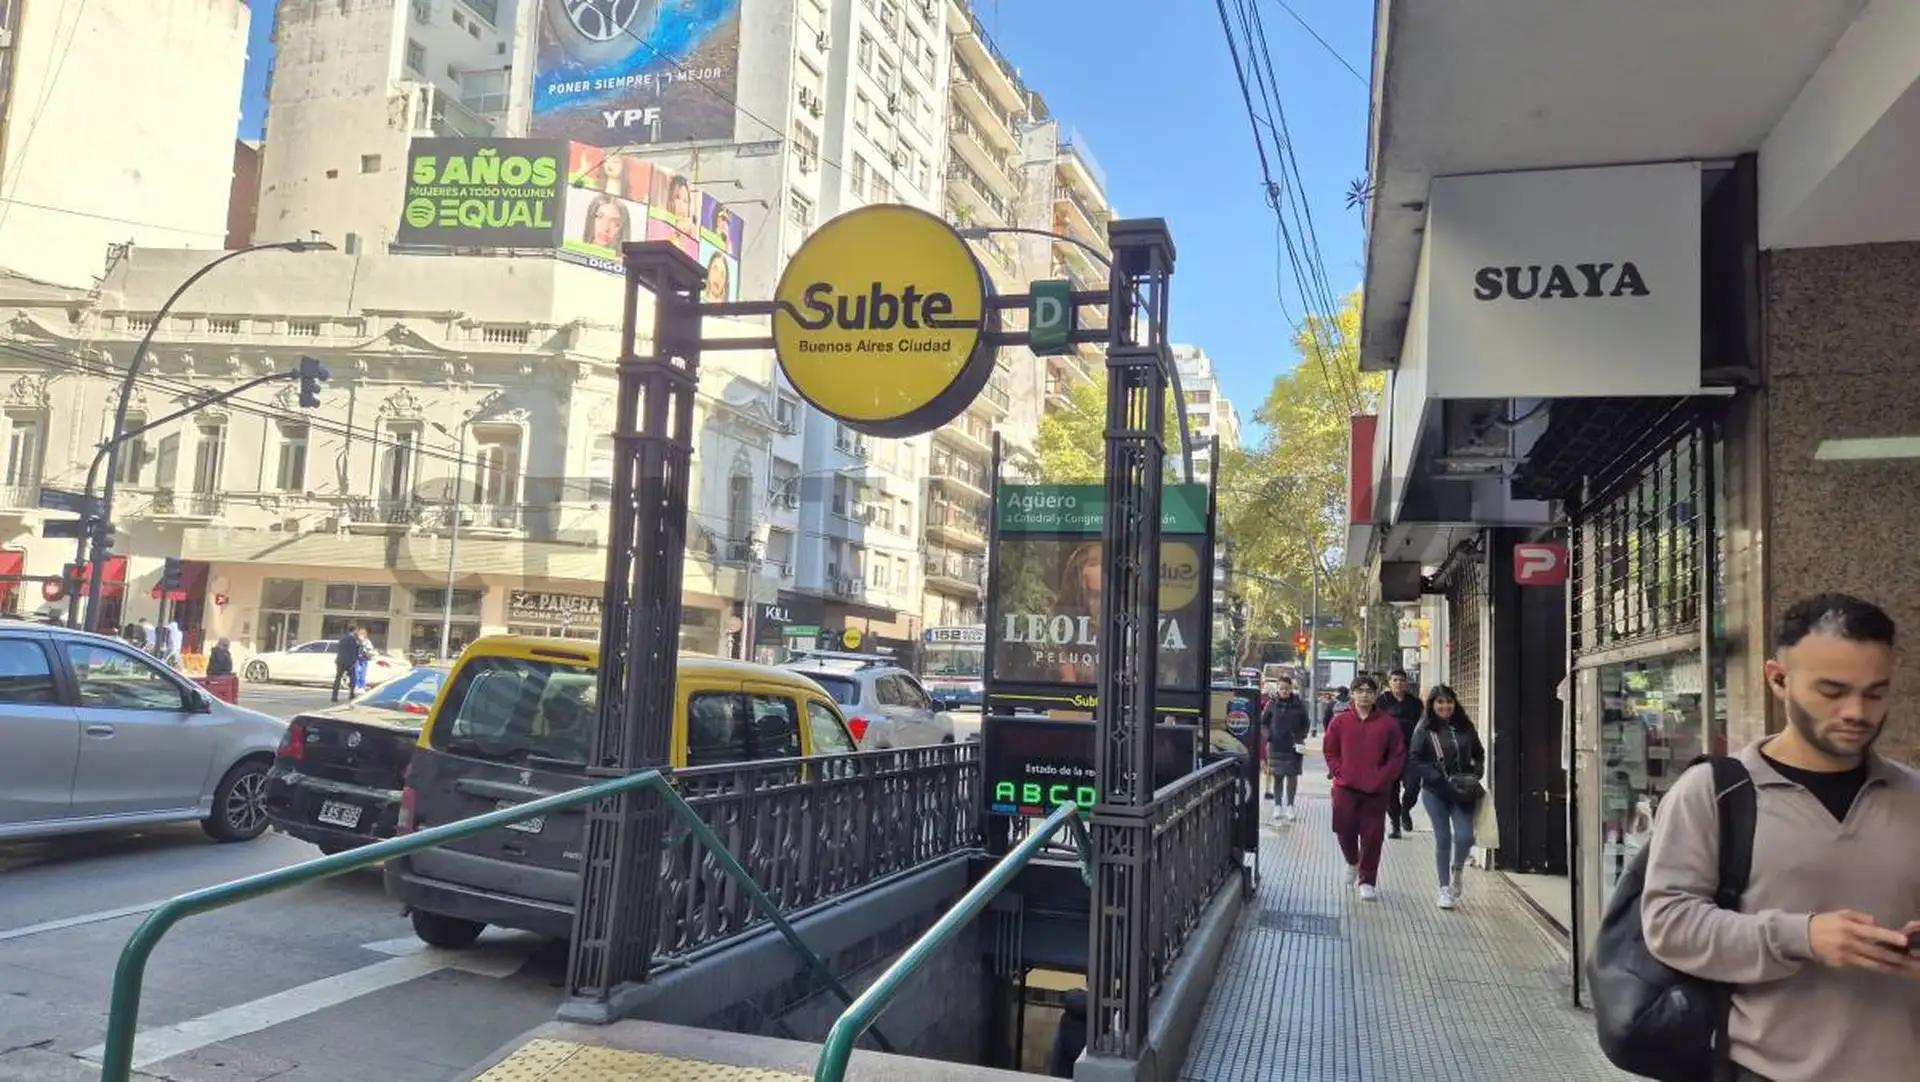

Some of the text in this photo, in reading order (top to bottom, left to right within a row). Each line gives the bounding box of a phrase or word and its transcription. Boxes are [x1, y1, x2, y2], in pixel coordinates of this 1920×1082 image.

[549, 79, 590, 95] PONER
[594, 74, 652, 90] SIEMPRE
[677, 67, 722, 82] MEJOR
[602, 107, 662, 128] YPF
[413, 148, 557, 187] 5 AÑOS
[409, 187, 555, 198] MUJERES A TODO VOLUMEN
[440, 198, 553, 229] EQUAL
[1473, 262, 1650, 301] SUAYA
[802, 281, 953, 331] Subte
[1036, 296, 1062, 328] D
[799, 338, 951, 353] Buenos Aires Ciudad
[1007, 491, 1077, 512] Agüero
[1065, 513, 1104, 526] Congre
[540, 593, 600, 614] PANERA
[935, 630, 961, 640] 152
[1025, 763, 1057, 775] Estado
[1059, 765, 1071, 776] de
[1073, 766, 1082, 777] la
[996, 782, 1097, 807] A B C D
